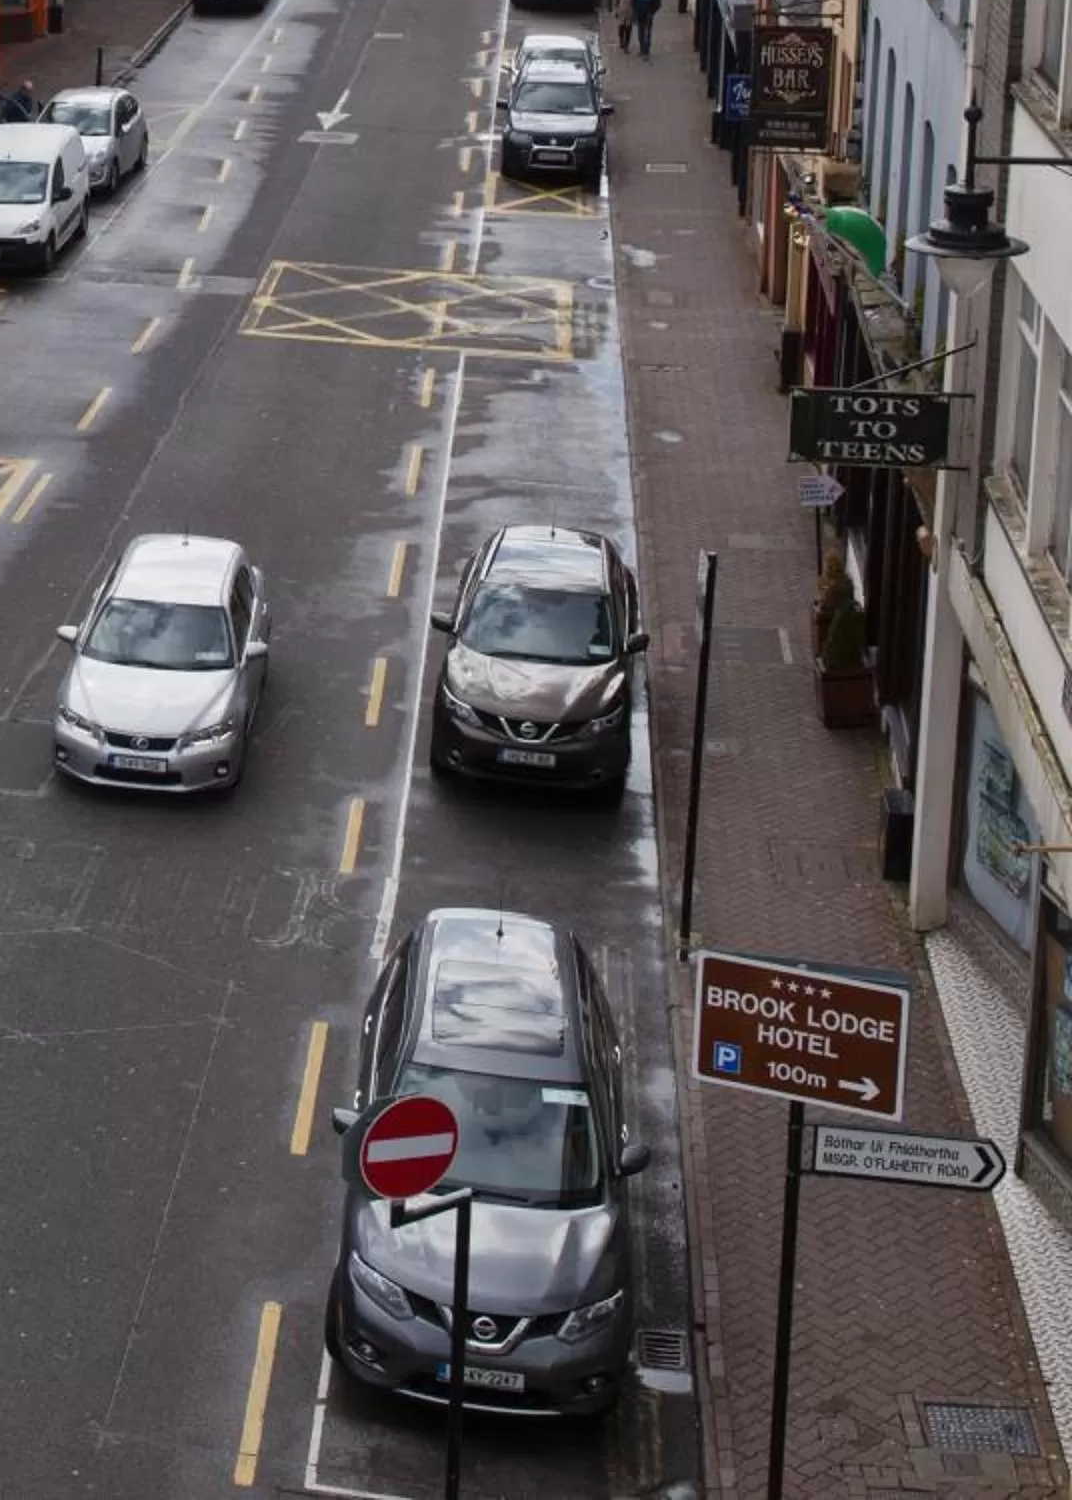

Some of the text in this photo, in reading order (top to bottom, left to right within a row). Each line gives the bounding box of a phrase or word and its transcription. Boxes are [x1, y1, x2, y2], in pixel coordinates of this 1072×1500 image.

[773, 67, 810, 89] BAR
[830, 395, 920, 417] TOTS
[850, 420, 897, 440] TO
[816, 440, 926, 463] TEENS
[706, 985, 896, 1043] BROOK LODGE
[757, 1022, 839, 1059] HOTEL
[717, 1046, 736, 1067] P
[767, 1061, 827, 1089] 100m
[864, 1156, 933, 1175] O'FLAHERTY
[937, 1163, 969, 1179] ROAD
